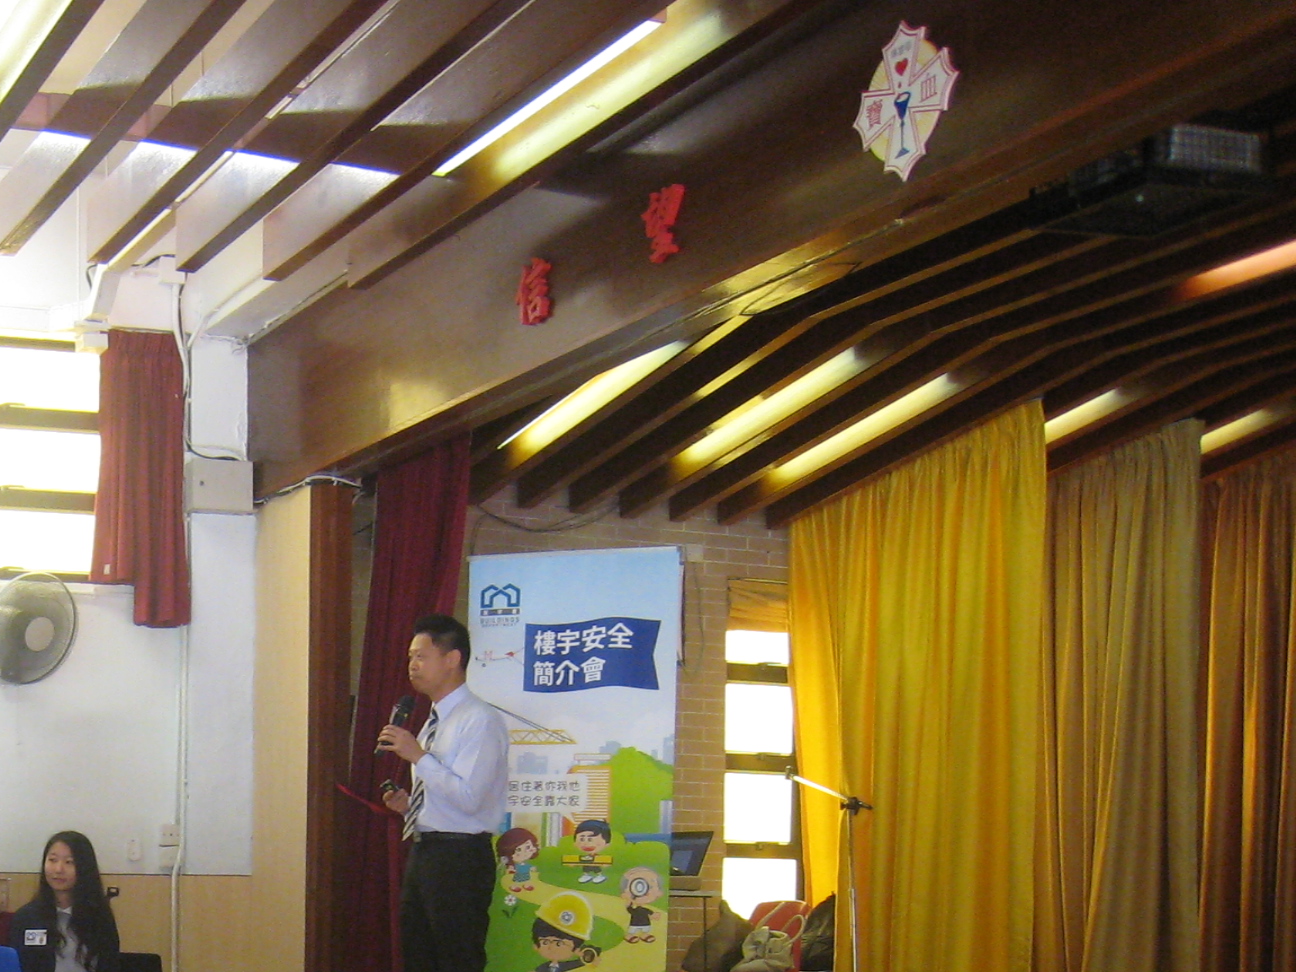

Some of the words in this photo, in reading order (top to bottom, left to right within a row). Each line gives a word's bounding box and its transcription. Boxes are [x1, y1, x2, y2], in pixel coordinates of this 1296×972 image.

[516, 258, 551, 325] 信
[533, 622, 634, 655] 樓宇安全
[533, 656, 606, 687] 簡介會
